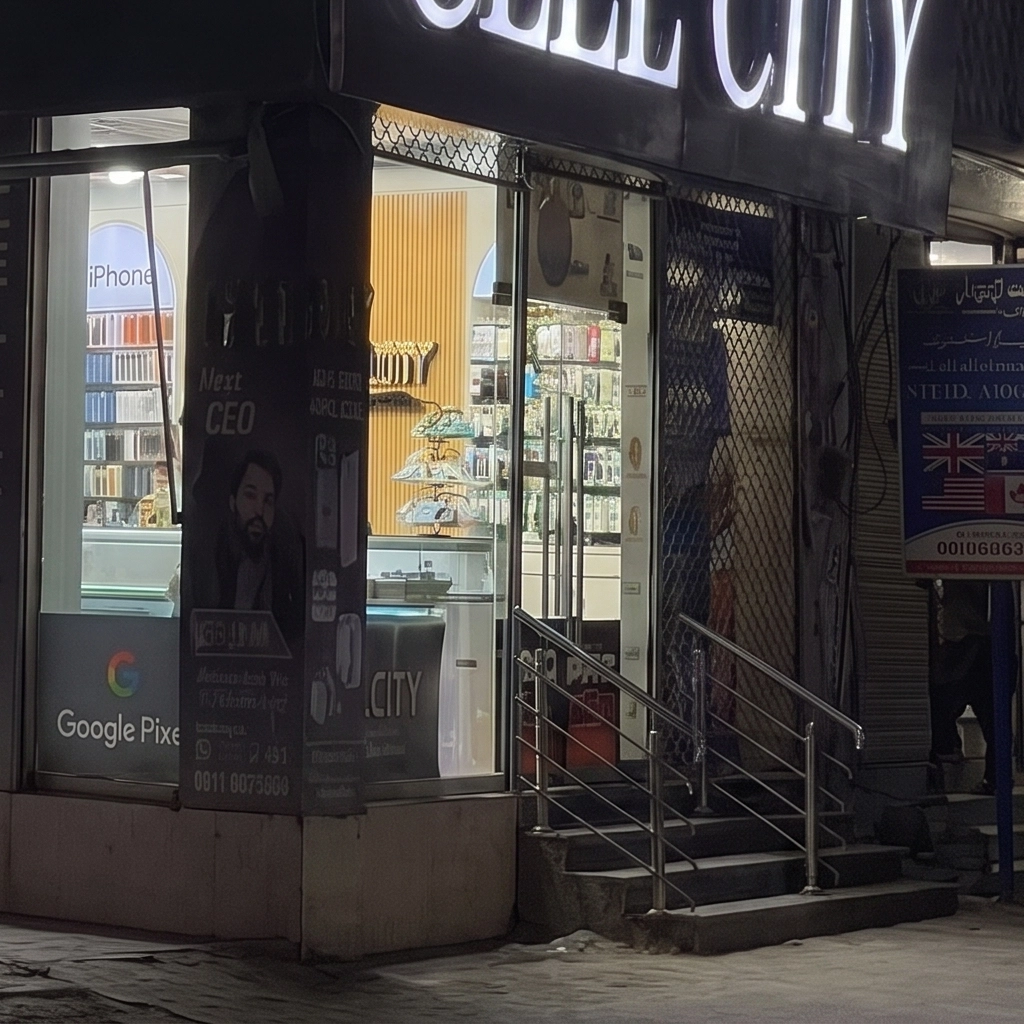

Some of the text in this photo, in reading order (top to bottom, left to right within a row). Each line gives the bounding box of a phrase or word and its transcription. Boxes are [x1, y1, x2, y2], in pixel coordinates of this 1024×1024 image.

[88, 264, 154, 288] iPhone
[199, 367, 243, 393] Next
[205, 400, 256, 435] CEO
[365, 670, 423, 718] CITY
[57, 708, 136, 749] Google
